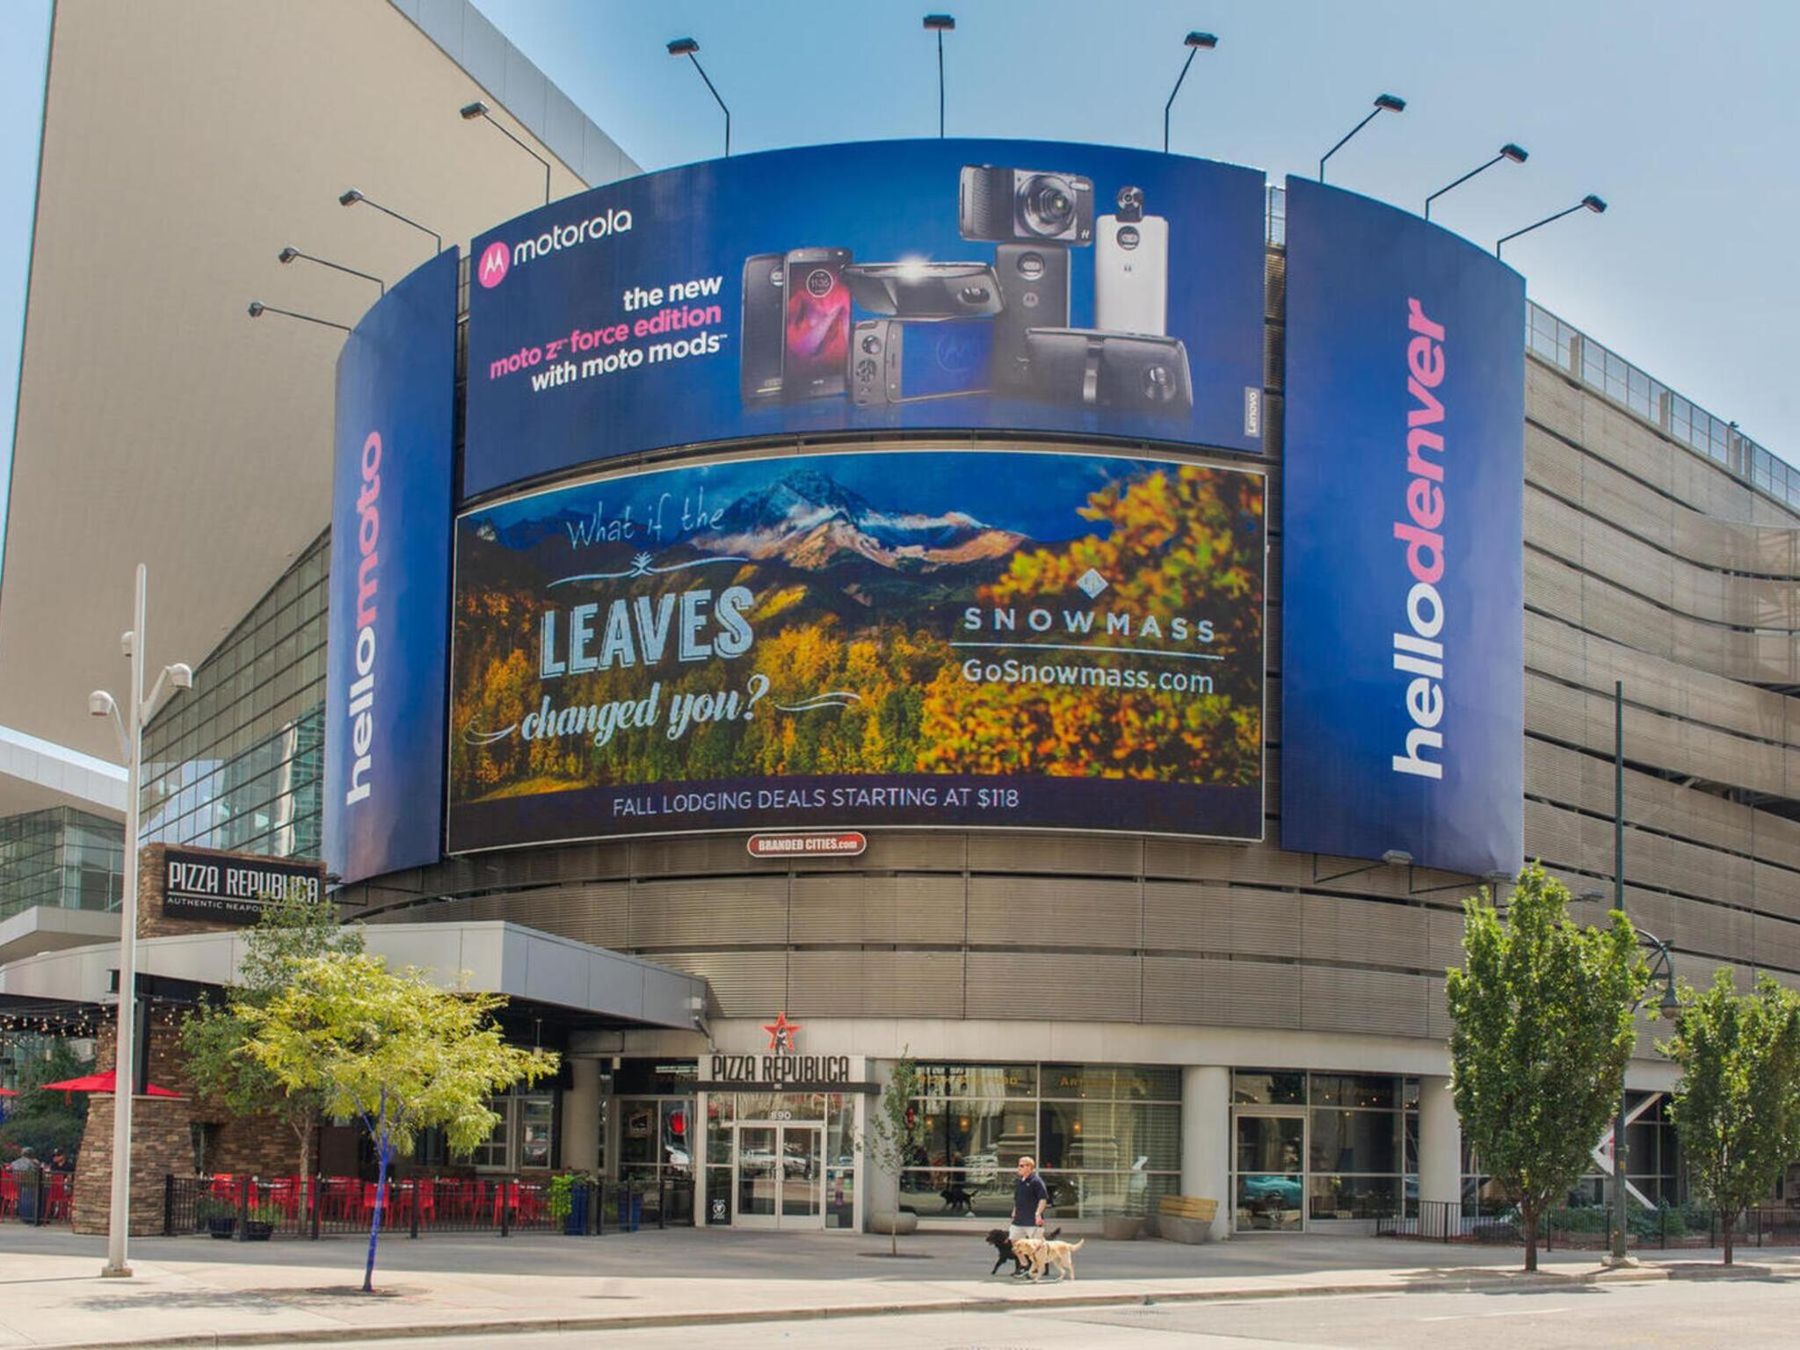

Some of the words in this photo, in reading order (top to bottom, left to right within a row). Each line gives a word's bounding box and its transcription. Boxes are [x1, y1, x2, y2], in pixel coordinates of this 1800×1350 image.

[513, 208, 633, 265] motorola
[623, 286, 664, 312] the
[669, 275, 723, 303] new
[490, 344, 542, 380] moto
[571, 322, 629, 354] force
[634, 304, 722, 336] edition
[531, 361, 577, 392] with
[582, 349, 643, 379] moto
[566, 501, 634, 550] What
[648, 493, 671, 541] if
[681, 486, 725, 532] the
[539, 585, 755, 679] LEAVES
[963, 607, 1215, 643] SNOWMASS
[962, 658, 1213, 694] GoSnowmass.com
[521, 682, 661, 747] changed
[666, 674, 770, 741] you?
[613, 797, 657, 817] FALL
[662, 791, 752, 813] LODGING
[757, 788, 826, 809] DEALS
[831, 787, 938, 807] STARTING
[943, 787, 973, 807] AT
[977, 788, 1020, 809] $118
[758, 839, 804, 851] BRANDED
[168, 861, 219, 894] PIZZA
[167, 897, 223, 909] AUTHENTIC
[712, 1055, 756, 1082] PIZZA
[762, 1055, 850, 1082] REPUBLICA
